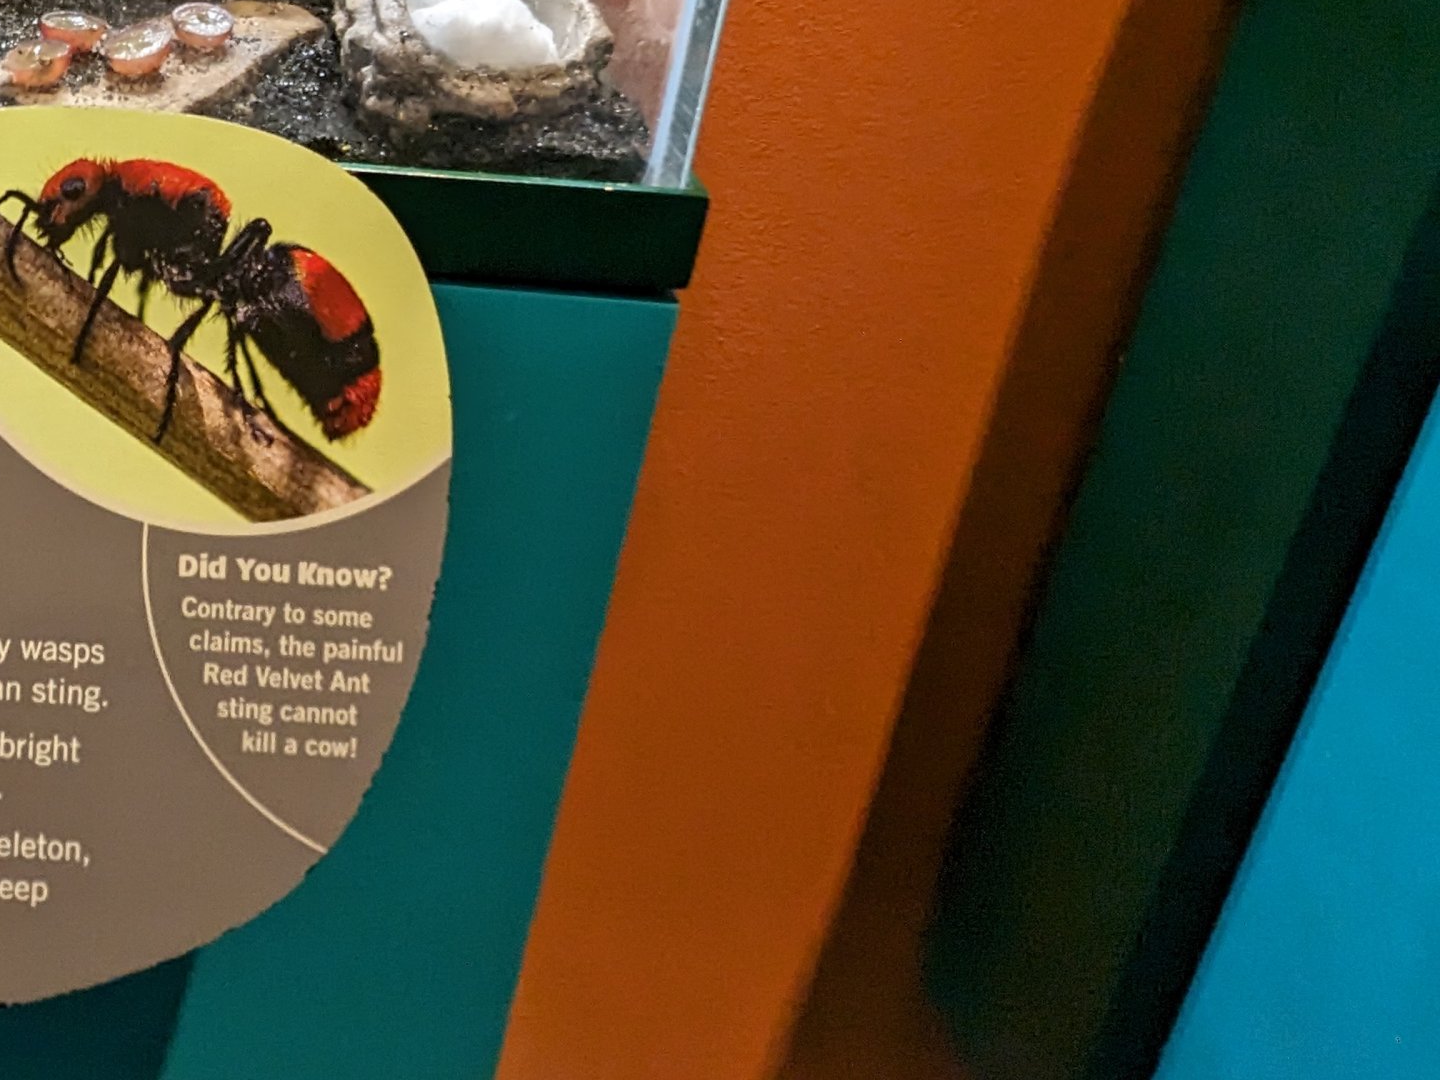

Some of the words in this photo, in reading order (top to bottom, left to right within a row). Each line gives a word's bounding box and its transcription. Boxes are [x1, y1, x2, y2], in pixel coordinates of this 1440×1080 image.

[178, 552, 228, 580] Did
[235, 557, 291, 584] You
[297, 560, 393, 591] Know?
[181, 595, 277, 628] Contrary
[282, 602, 306, 625] to
[312, 608, 373, 629] some
[20, 639, 105, 670] wasps
[189, 629, 271, 659] claims,
[278, 634, 316, 658] the
[322, 638, 404, 664] painful
[203, 661, 248, 687] Red
[255, 665, 324, 691] Velvet
[329, 669, 371, 694] Ant
[31, 677, 109, 713] sting.
[217, 696, 273, 726] sting
[279, 704, 358, 727] cannot
[241, 729, 277, 754] kill
[283, 737, 298, 755] a
[304, 737, 358, 759] cow!
